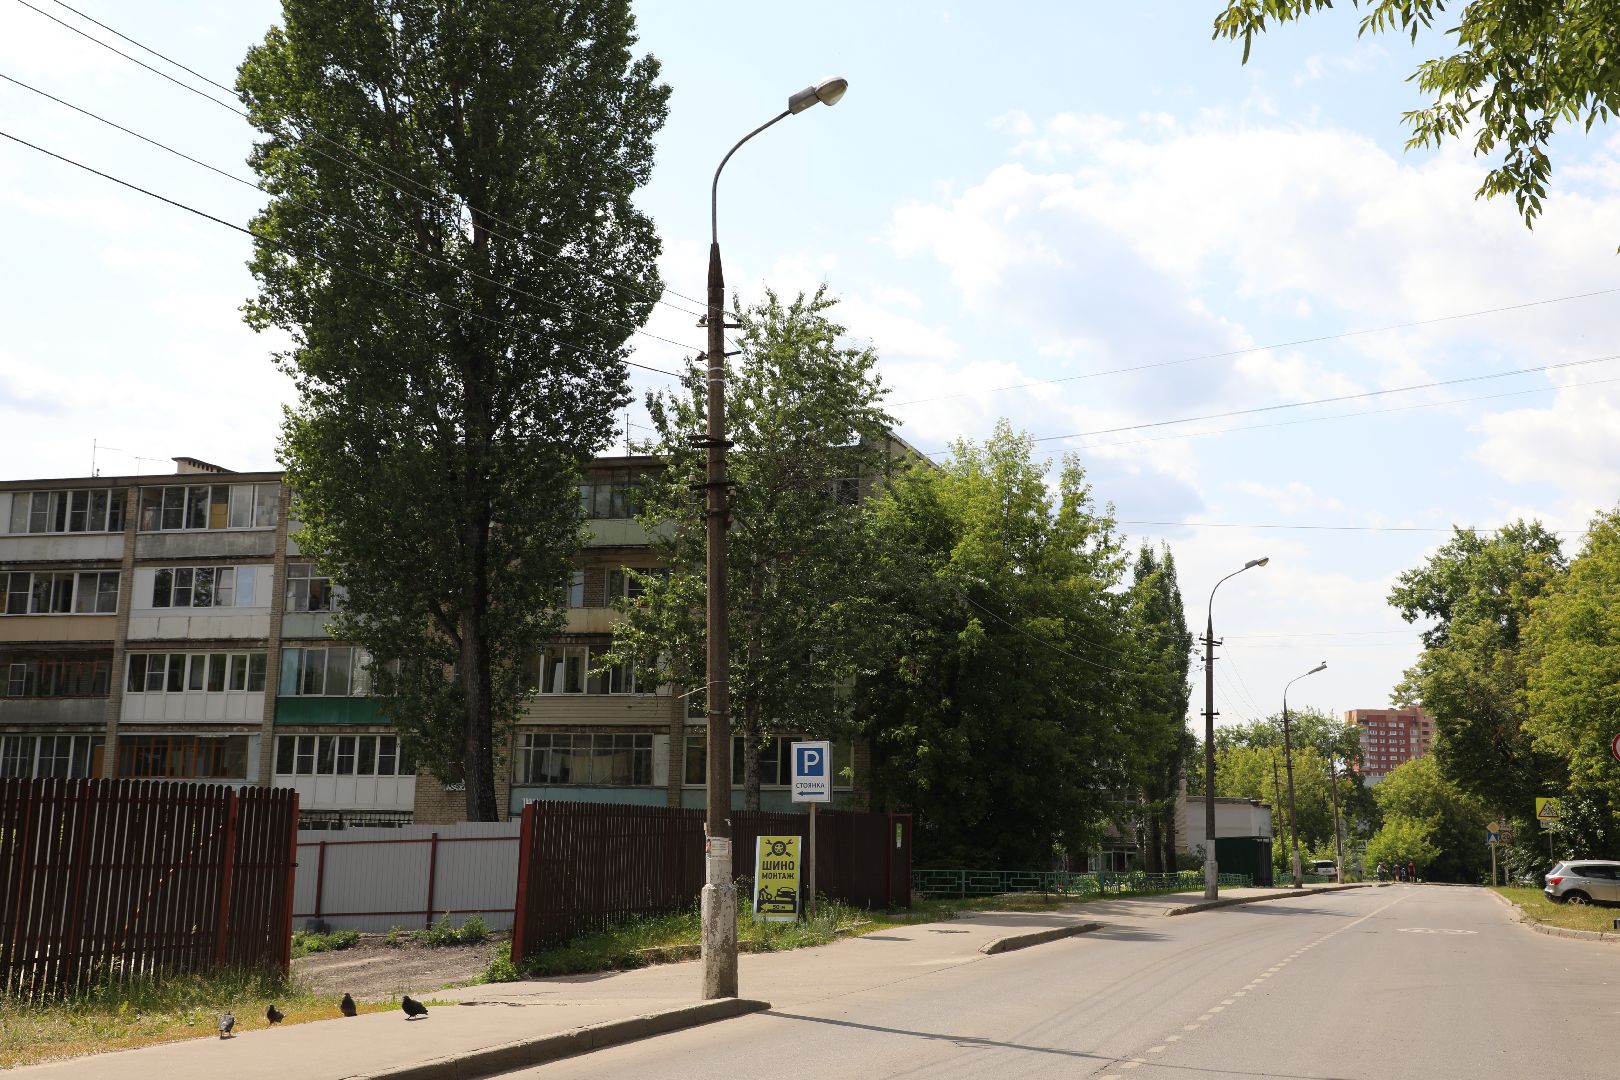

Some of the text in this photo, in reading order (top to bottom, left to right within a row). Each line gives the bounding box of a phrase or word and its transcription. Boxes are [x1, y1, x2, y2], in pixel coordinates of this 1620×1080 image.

[803, 750, 820, 773] P
[762, 860, 795, 871] ШИНО
[761, 872, 795, 880] МОНТАЖ
